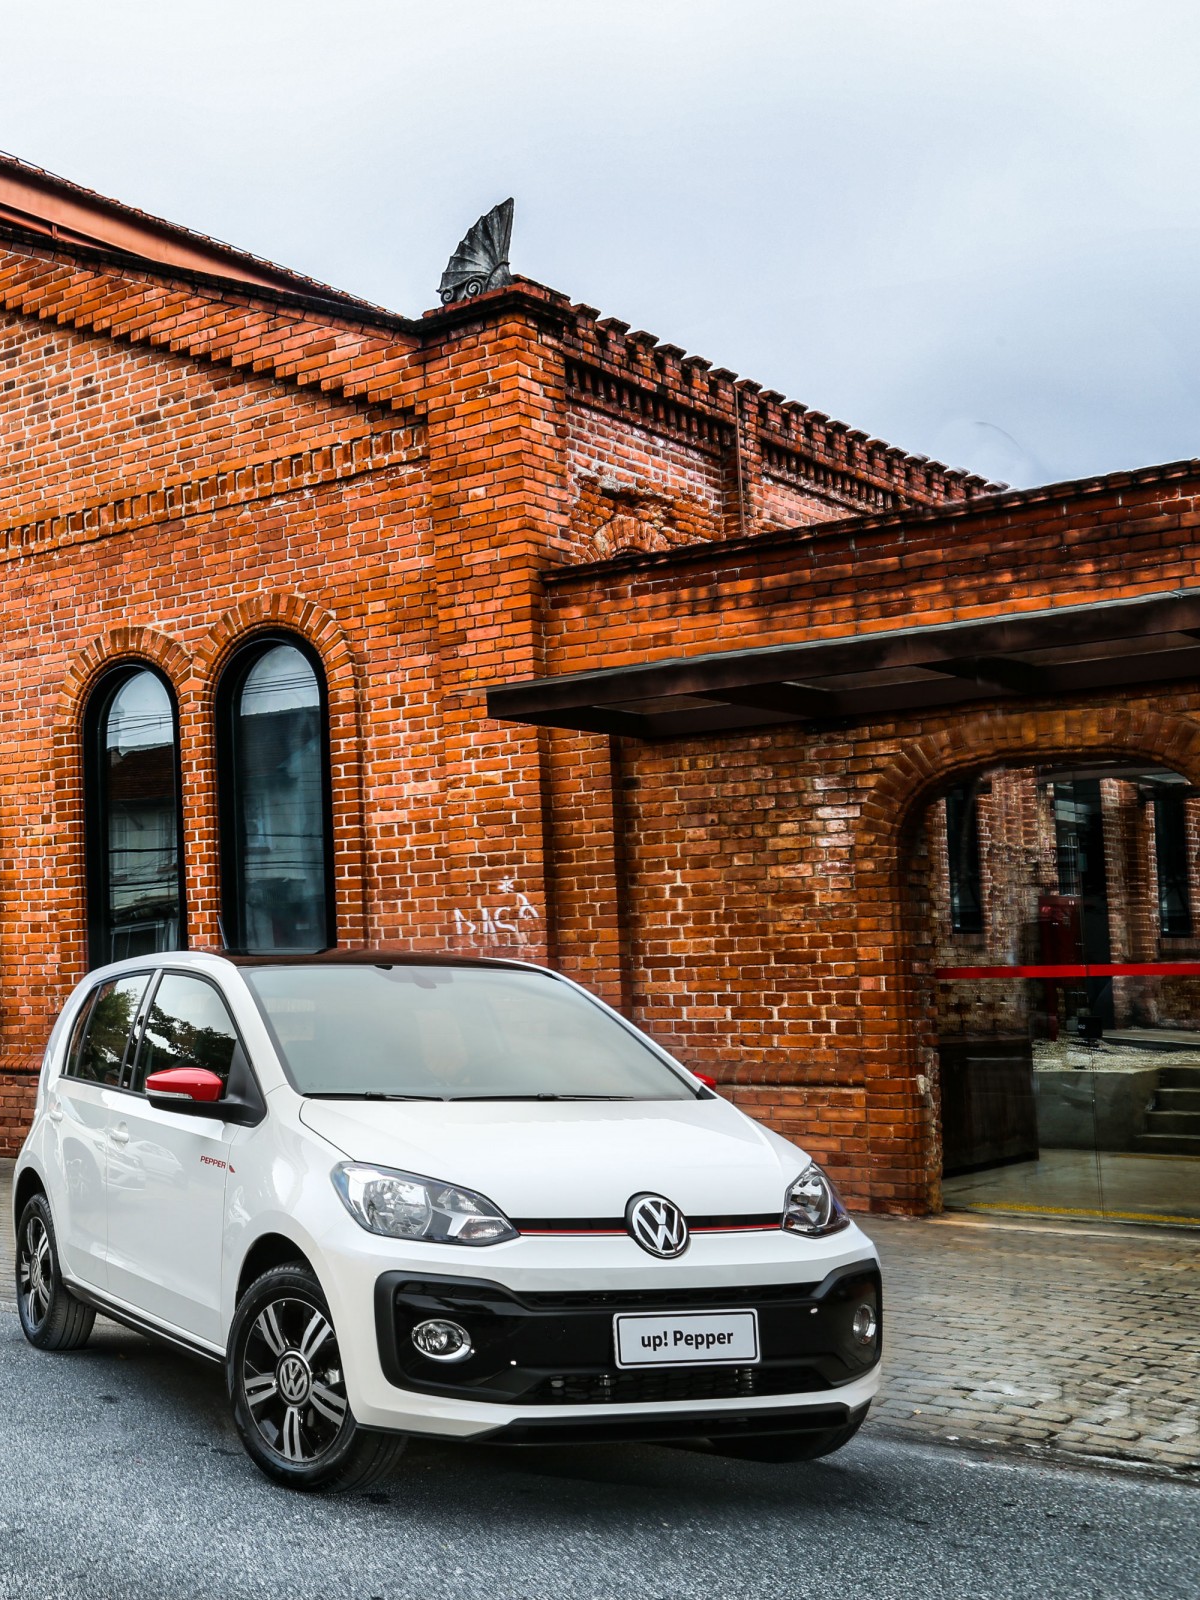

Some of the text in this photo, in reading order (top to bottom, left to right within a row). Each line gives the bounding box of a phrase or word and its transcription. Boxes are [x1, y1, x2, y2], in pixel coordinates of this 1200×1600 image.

[200, 1155, 226, 1169] PEPPER
[641, 1330, 734, 1351] up! Pepper
